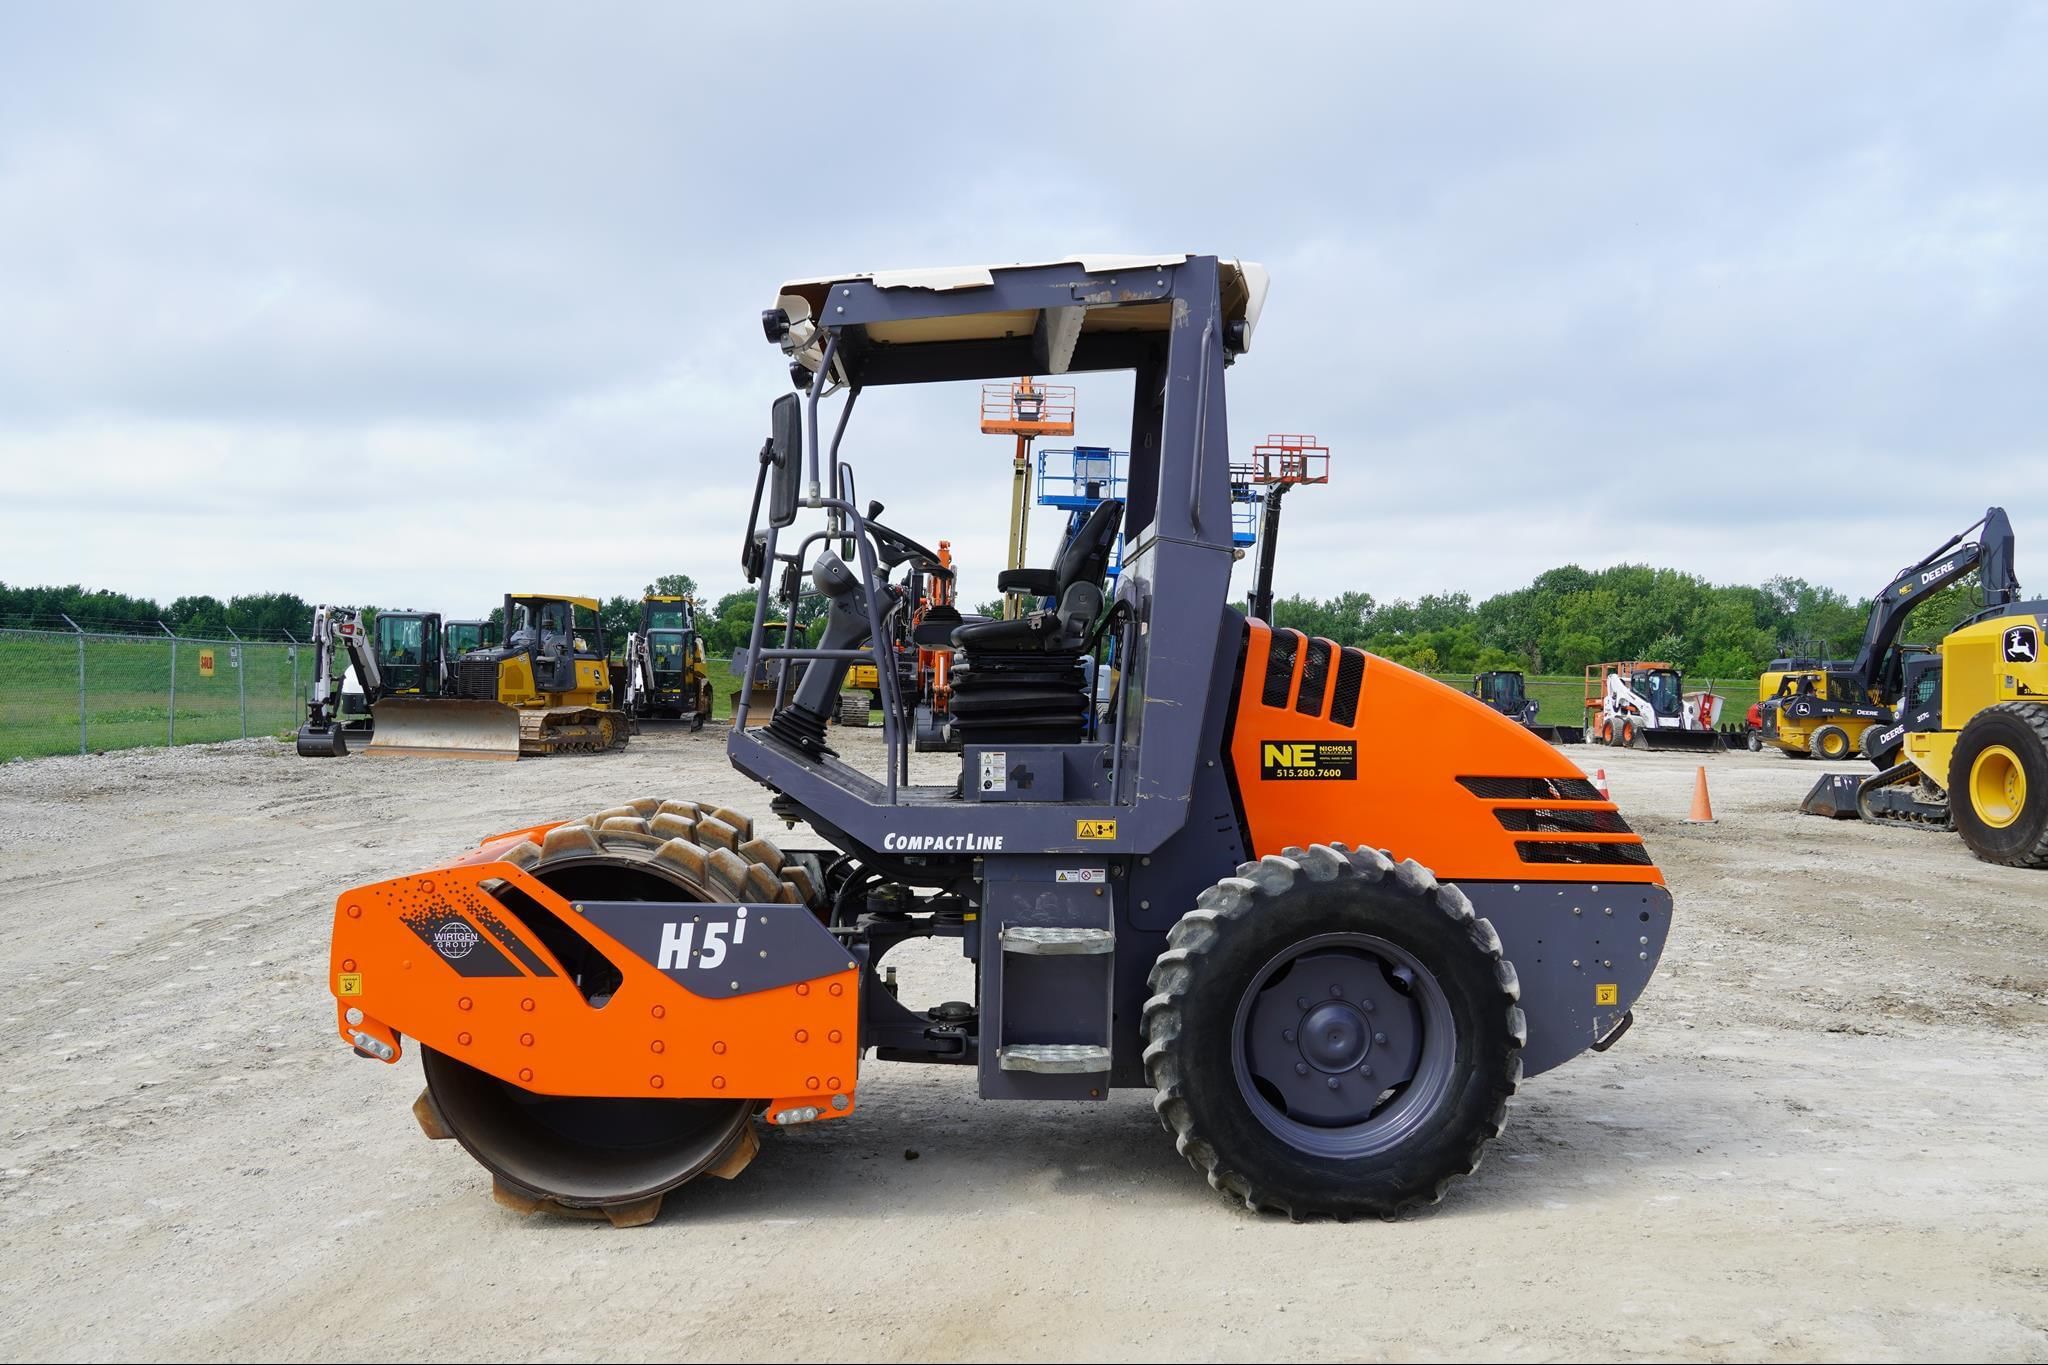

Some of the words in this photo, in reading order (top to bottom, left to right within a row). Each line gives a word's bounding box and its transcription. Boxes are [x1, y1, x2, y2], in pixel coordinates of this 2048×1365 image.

[1921, 560, 1954, 585] DEERE
[200, 656, 213, 669] SOLD
[1880, 724, 1905, 744] DEERE
[1264, 744, 1316, 767] NE
[1277, 769, 1341, 777] 515.280.7600
[434, 932, 478, 940] WIRTGEN
